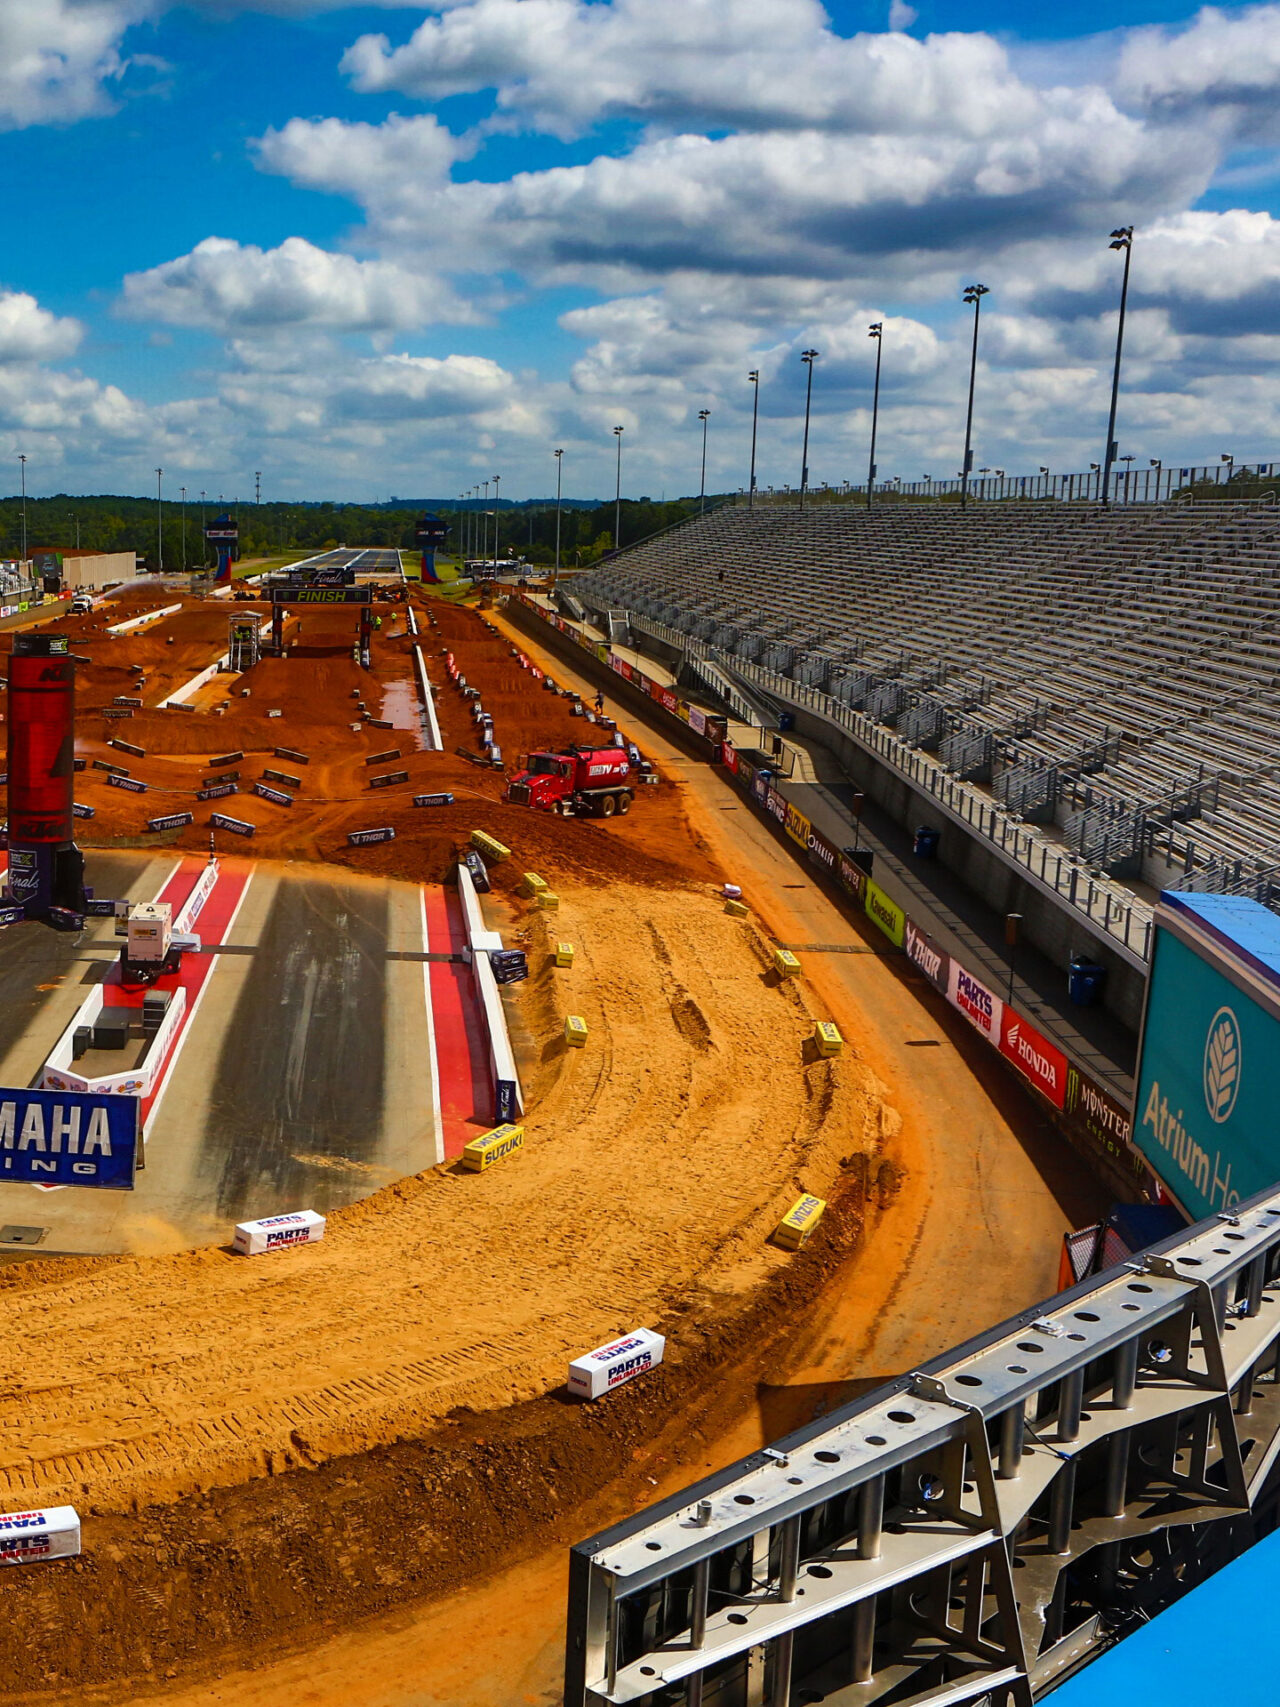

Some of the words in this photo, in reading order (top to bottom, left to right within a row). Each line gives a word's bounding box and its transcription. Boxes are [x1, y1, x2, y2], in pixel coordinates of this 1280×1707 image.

[297, 591, 347, 602] FINISH
[120, 780, 140, 791] THOR
[210, 786, 231, 796] THOR
[266, 792, 287, 803] THOR
[163, 817, 186, 828] THOR
[223, 821, 248, 833] THOR
[786, 808, 811, 843] SUZUKI
[362, 832, 385, 842] THOR
[871, 891, 897, 932] Kawasaki
[915, 936, 942, 981] THOR
[958, 970, 993, 1016] PARTS
[956, 991, 991, 1033] UNLIMITED
[1018, 1036, 1057, 1089] HONDA
[1081, 1083, 1130, 1141] MONSTER
[485, 1134, 522, 1165] SUZUKI
[1086, 1119, 1121, 1156] ENERGY
[1142, 1081, 1210, 1197] Atrium
[787, 1197, 819, 1227] SUZUKI
[267, 1227, 310, 1242] PARTS
[267, 1235, 309, 1248] UNLIMITED
[597, 1339, 645, 1361] PARTS
[608, 1351, 651, 1379] PARTS
[608, 1361, 652, 1387] UNLIMITED
